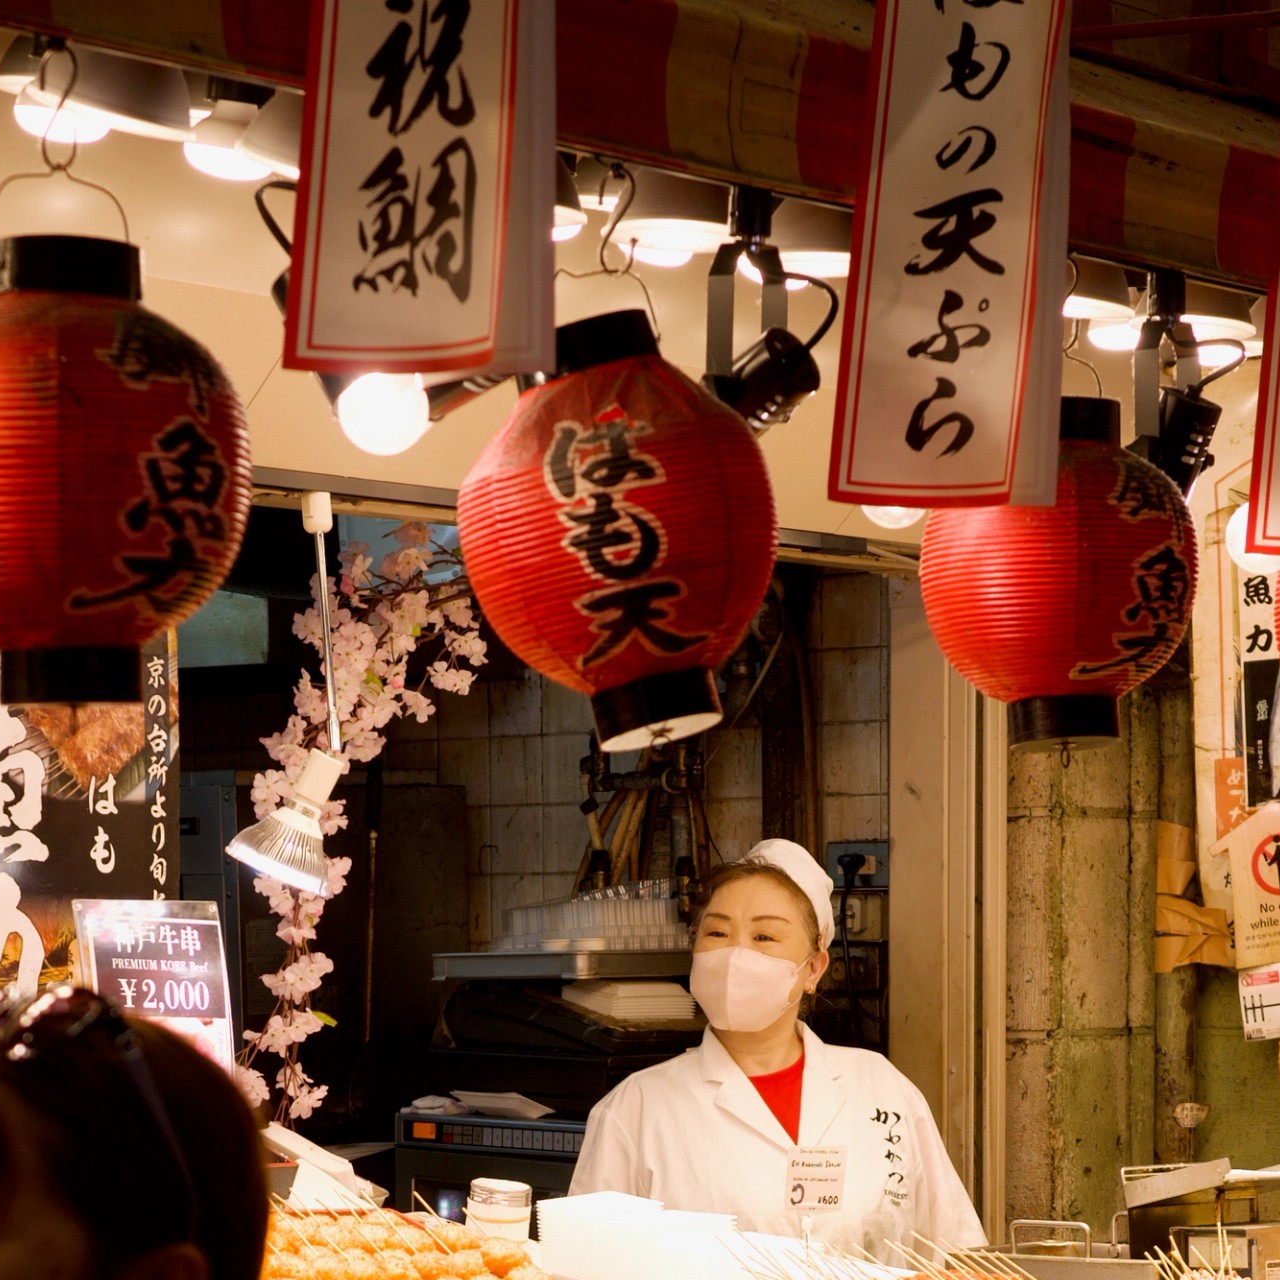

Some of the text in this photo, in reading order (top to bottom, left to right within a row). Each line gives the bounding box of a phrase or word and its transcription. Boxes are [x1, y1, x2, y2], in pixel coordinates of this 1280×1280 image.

[549, 408, 710, 667] はも天
[88, 773, 119, 874] はも
[1259, 902, 1275, 914] No
[1250, 917, 1280, 931] while
[112, 957, 209, 973] PREMIUM KOBE Beef
[817, 1195, 839, 1205] ¥600
